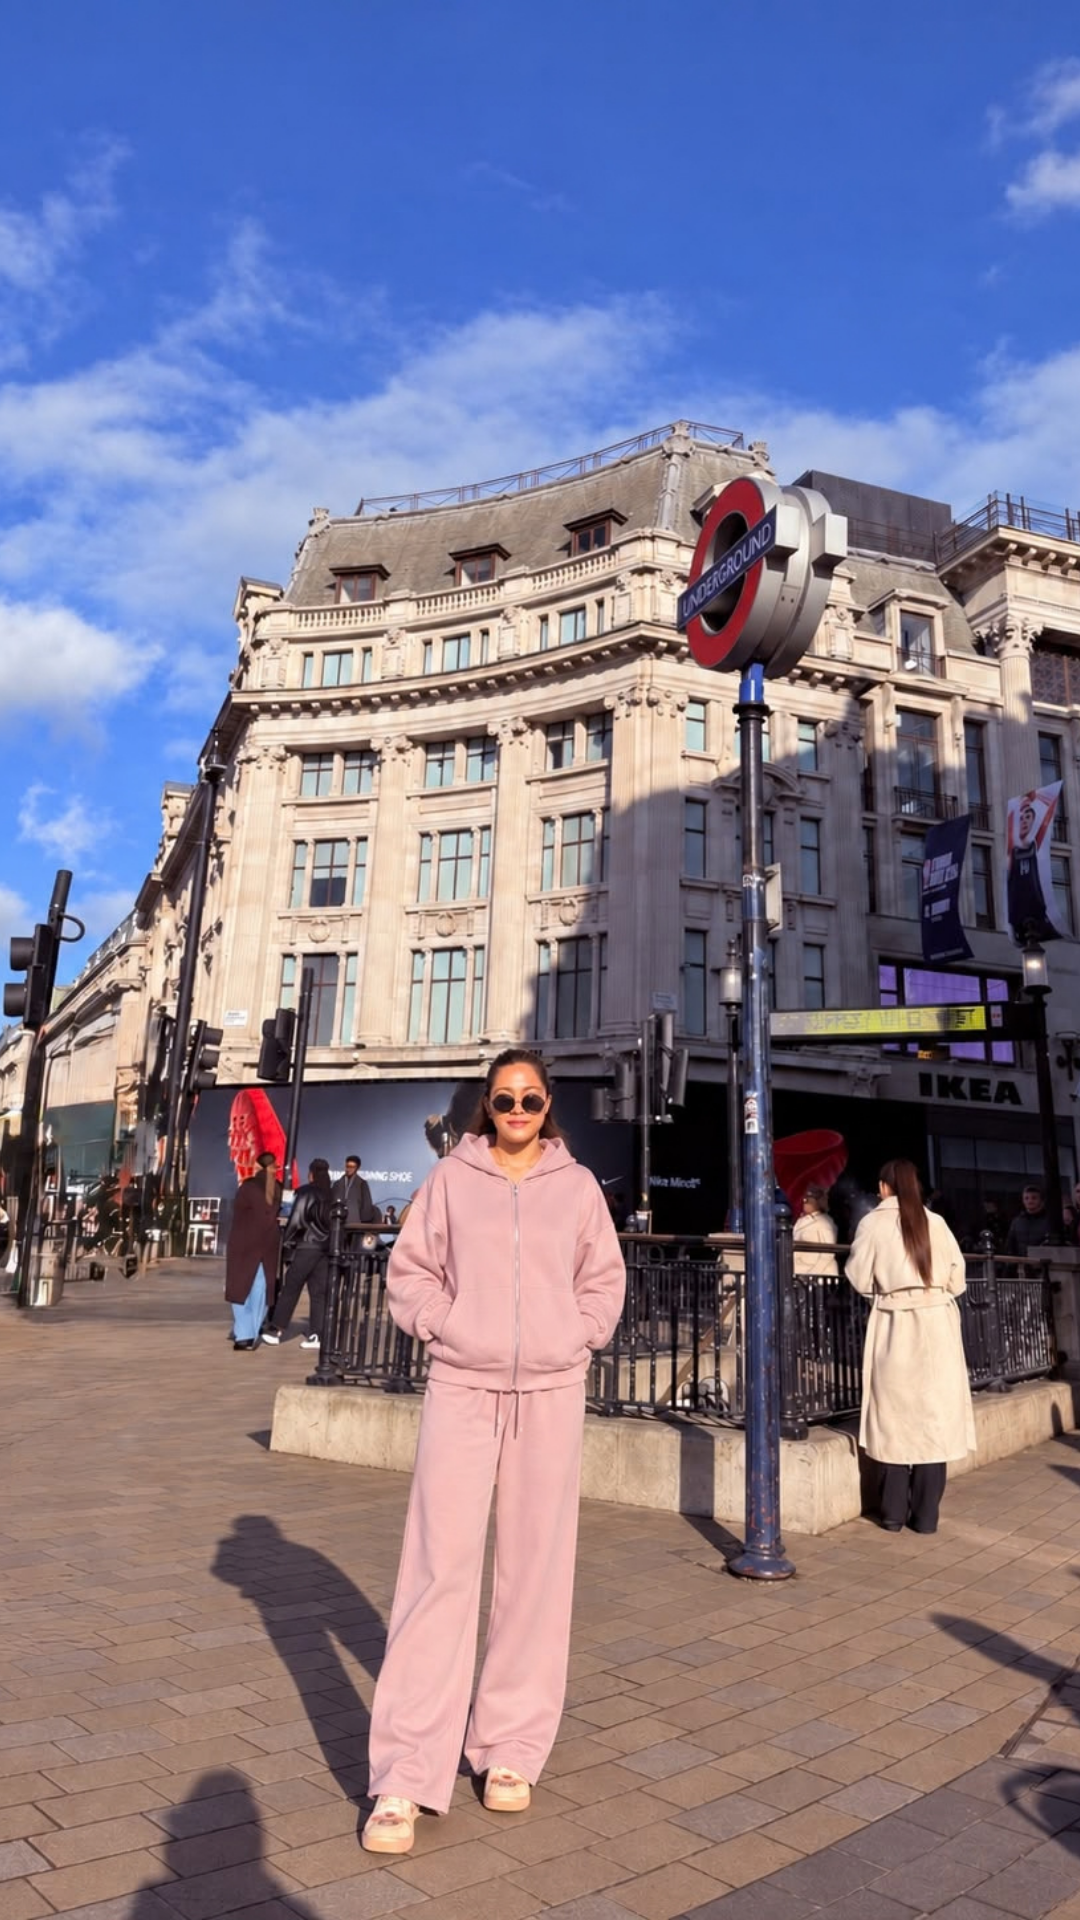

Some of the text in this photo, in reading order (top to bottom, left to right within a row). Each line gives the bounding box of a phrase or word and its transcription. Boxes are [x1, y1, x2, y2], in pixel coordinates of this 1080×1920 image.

[681, 522, 772, 617] UNDERGROUND
[918, 1072, 1022, 1106] IKEA
[389, 1171, 413, 1182] SHOE
